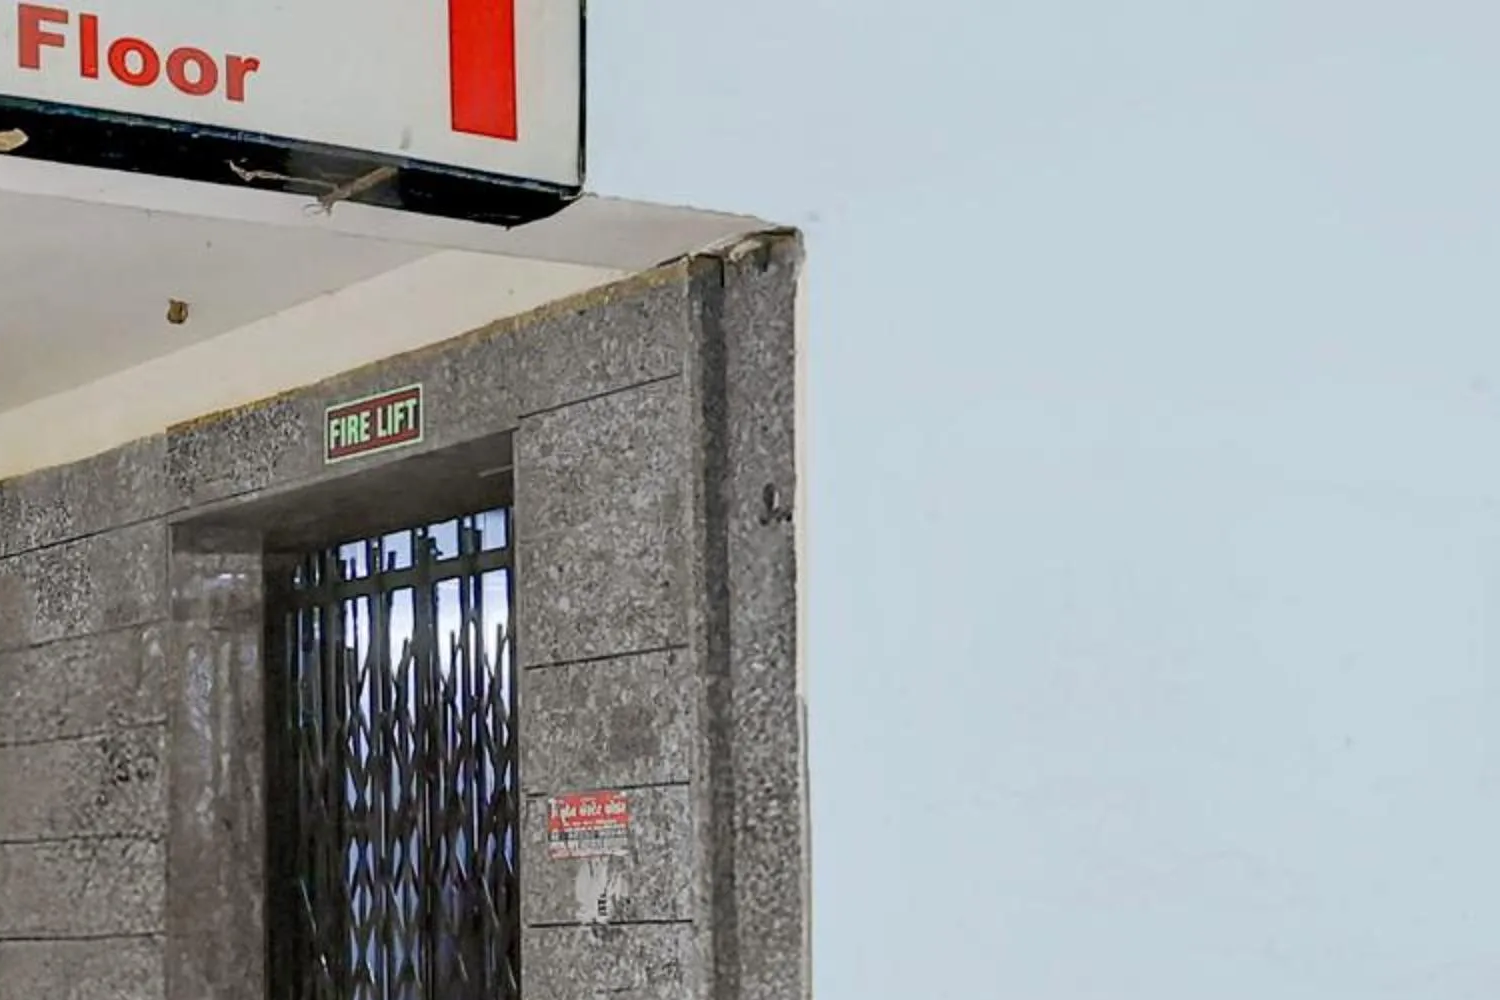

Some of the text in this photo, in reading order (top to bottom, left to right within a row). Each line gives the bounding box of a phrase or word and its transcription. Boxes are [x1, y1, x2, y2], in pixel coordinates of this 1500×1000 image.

[17, 3, 260, 102] Floor
[329, 398, 417, 450] FIRE LIFT
